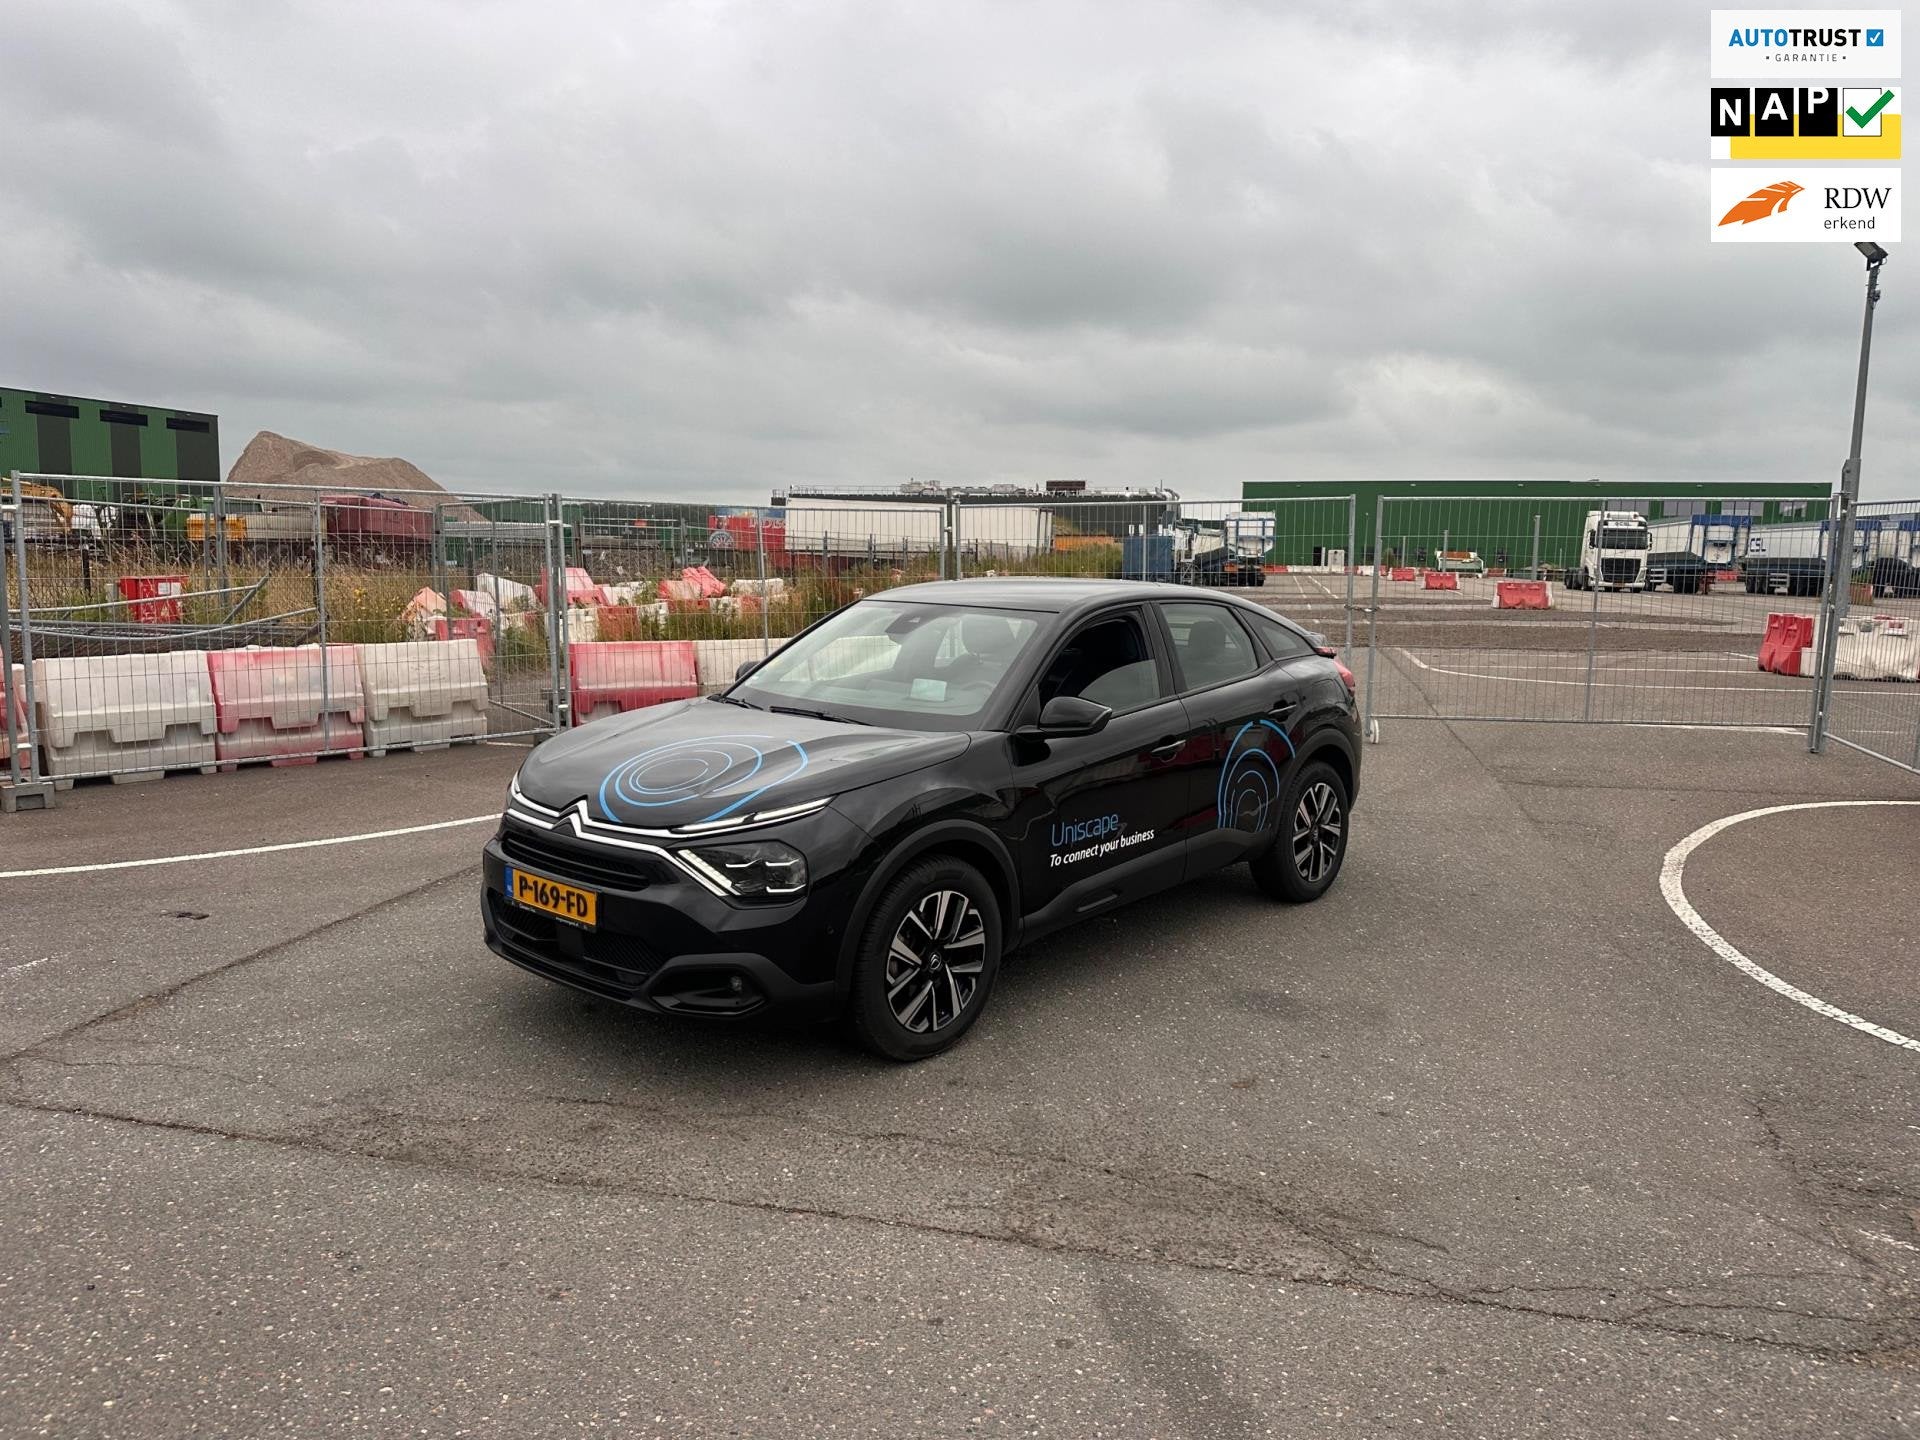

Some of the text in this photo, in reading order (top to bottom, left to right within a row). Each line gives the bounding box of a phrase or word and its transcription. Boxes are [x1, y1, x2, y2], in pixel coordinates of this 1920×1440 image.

[1050, 829, 1155, 867] To connect your business
[1051, 813, 1119, 847] Uniscape
[518, 875, 588, 918] P-169-FD
